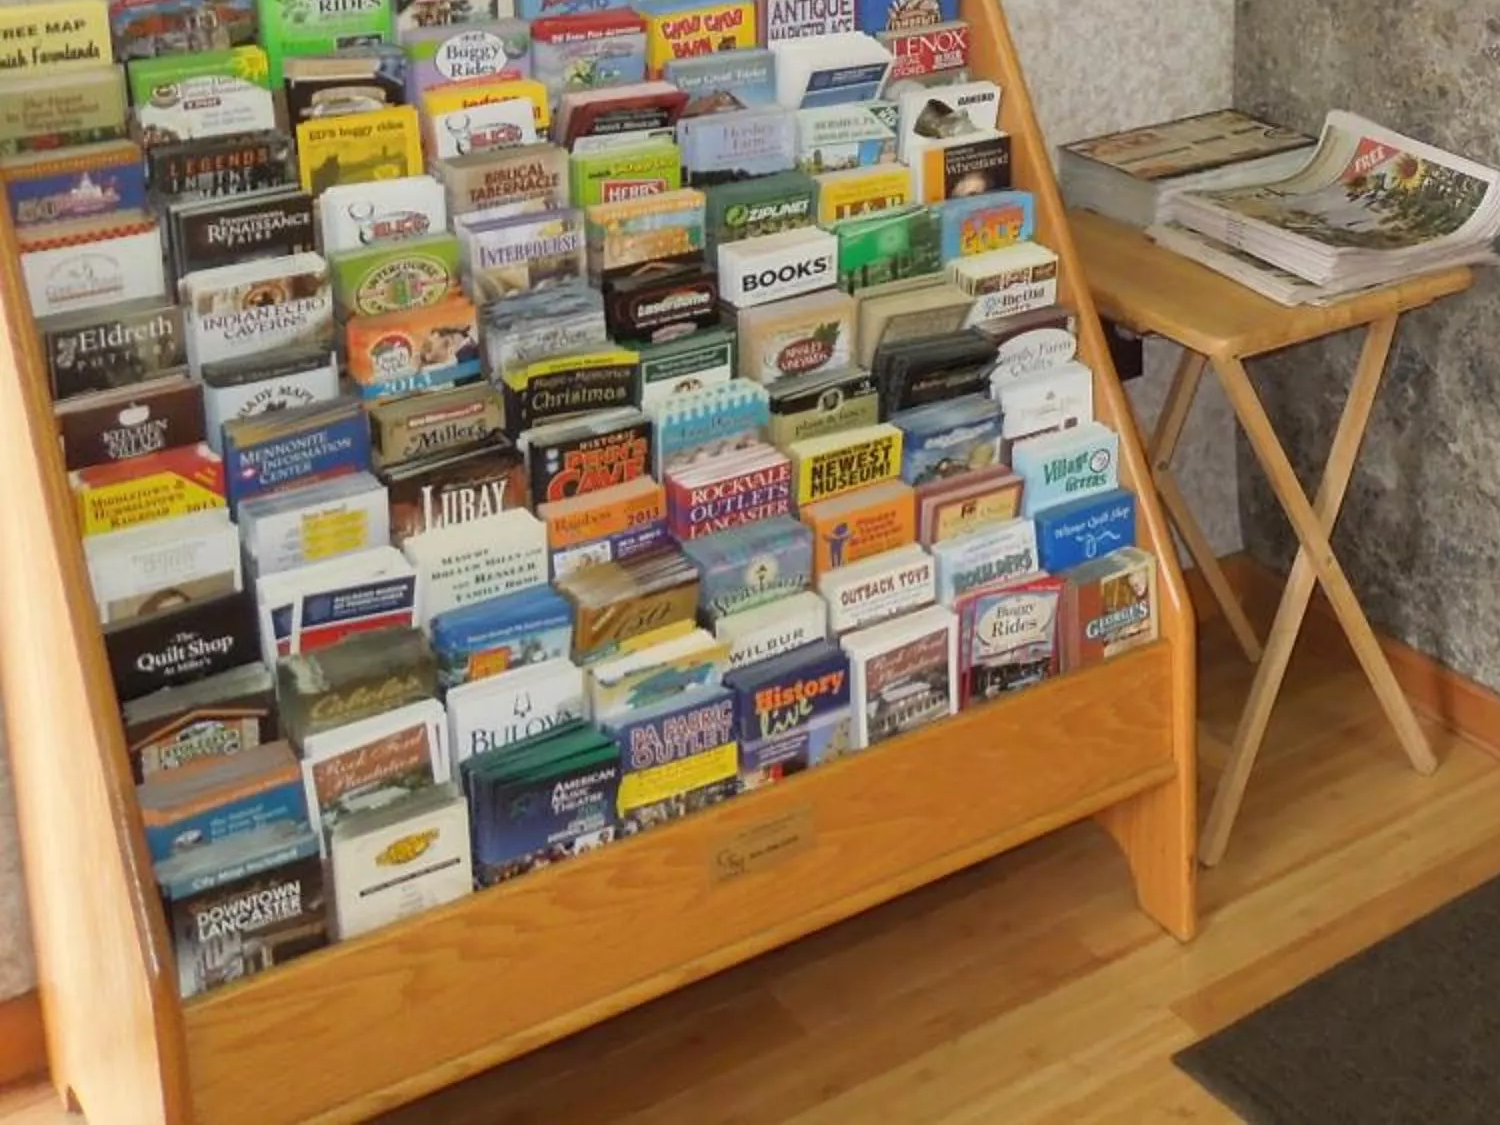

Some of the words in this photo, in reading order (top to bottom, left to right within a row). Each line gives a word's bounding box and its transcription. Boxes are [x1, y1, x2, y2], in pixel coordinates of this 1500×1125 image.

[0, 24, 38, 40] REE
[45, 19, 87, 35] MAP
[891, 28, 969, 60] LENOX
[446, 43, 500, 64] Buggy
[450, 60, 498, 78] Rides
[169, 148, 268, 180] LEGENDS
[484, 162, 546, 187] BIBLICAL
[1354, 144, 1388, 174] FREE
[469, 173, 560, 203] TABERNACLE
[206, 211, 312, 243] RENAISSANCE
[741, 257, 828, 293] BOOKS
[79, 315, 174, 352] Eldreth
[202, 304, 271, 332] INDIAN
[222, 313, 308, 341] CAVERNS
[531, 385, 628, 412] Christmas
[238, 431, 328, 466] MENNONITE
[260, 437, 352, 474] INFORMATION
[810, 445, 893, 480] NEWEST
[258, 459, 313, 486] CENTER
[546, 457, 646, 503] CAVE
[690, 465, 791, 506] ROCKVALE
[810, 462, 892, 498] MUSEUM!
[1042, 452, 1089, 485] Village
[1065, 474, 1108, 493] Greens
[689, 483, 789, 524] OUTLETS
[690, 500, 789, 540] LANCASTER
[840, 575, 896, 608] OUTBACK
[898, 563, 930, 588] TOYS
[175, 632, 196, 642] The
[991, 615, 1039, 638] Rides
[136, 644, 186, 672] Quilt
[187, 633, 235, 658] Shop
[727, 628, 805, 666] WILBUR
[754, 668, 845, 709] History
[470, 708, 574, 756] BULOVA
[662, 698, 735, 737] FABRIC
[759, 699, 815, 741] live
[631, 725, 731, 768] OUTLET
[553, 767, 616, 795] AMERICAN
[196, 878, 301, 927] DOWNTOWN
[199, 897, 303, 943] LANCASTER
